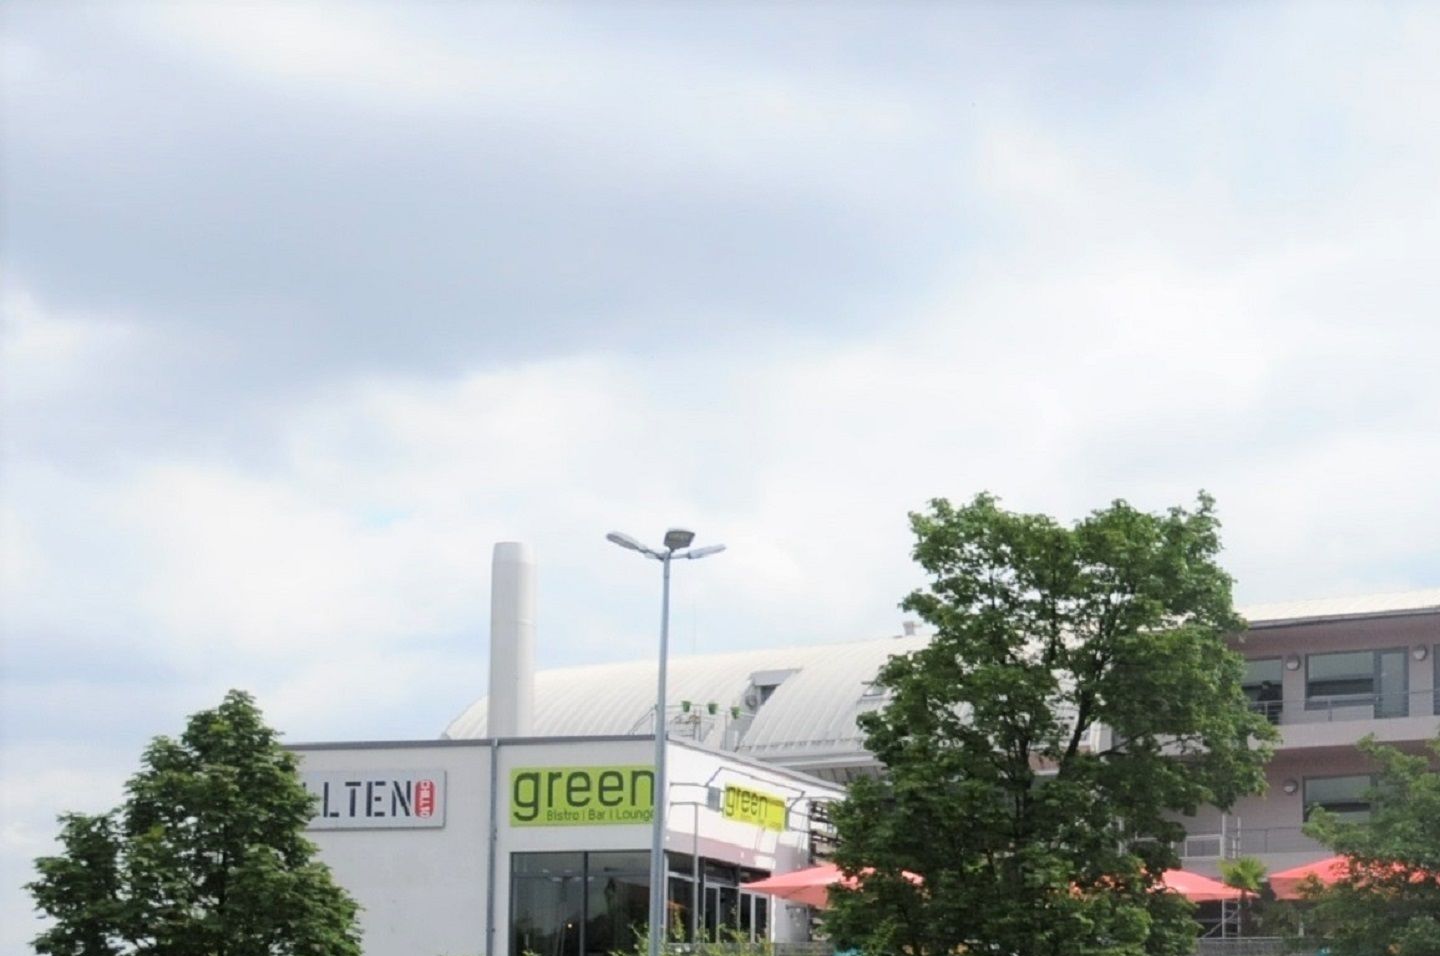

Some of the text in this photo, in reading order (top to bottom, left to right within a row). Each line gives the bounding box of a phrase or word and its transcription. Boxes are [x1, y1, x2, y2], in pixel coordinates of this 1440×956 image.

[302, 780, 412, 818] LTEN
[513, 770, 655, 821] green
[725, 786, 768, 818] green
[547, 809, 580, 821] Bistro
[588, 809, 606, 820] Bar
